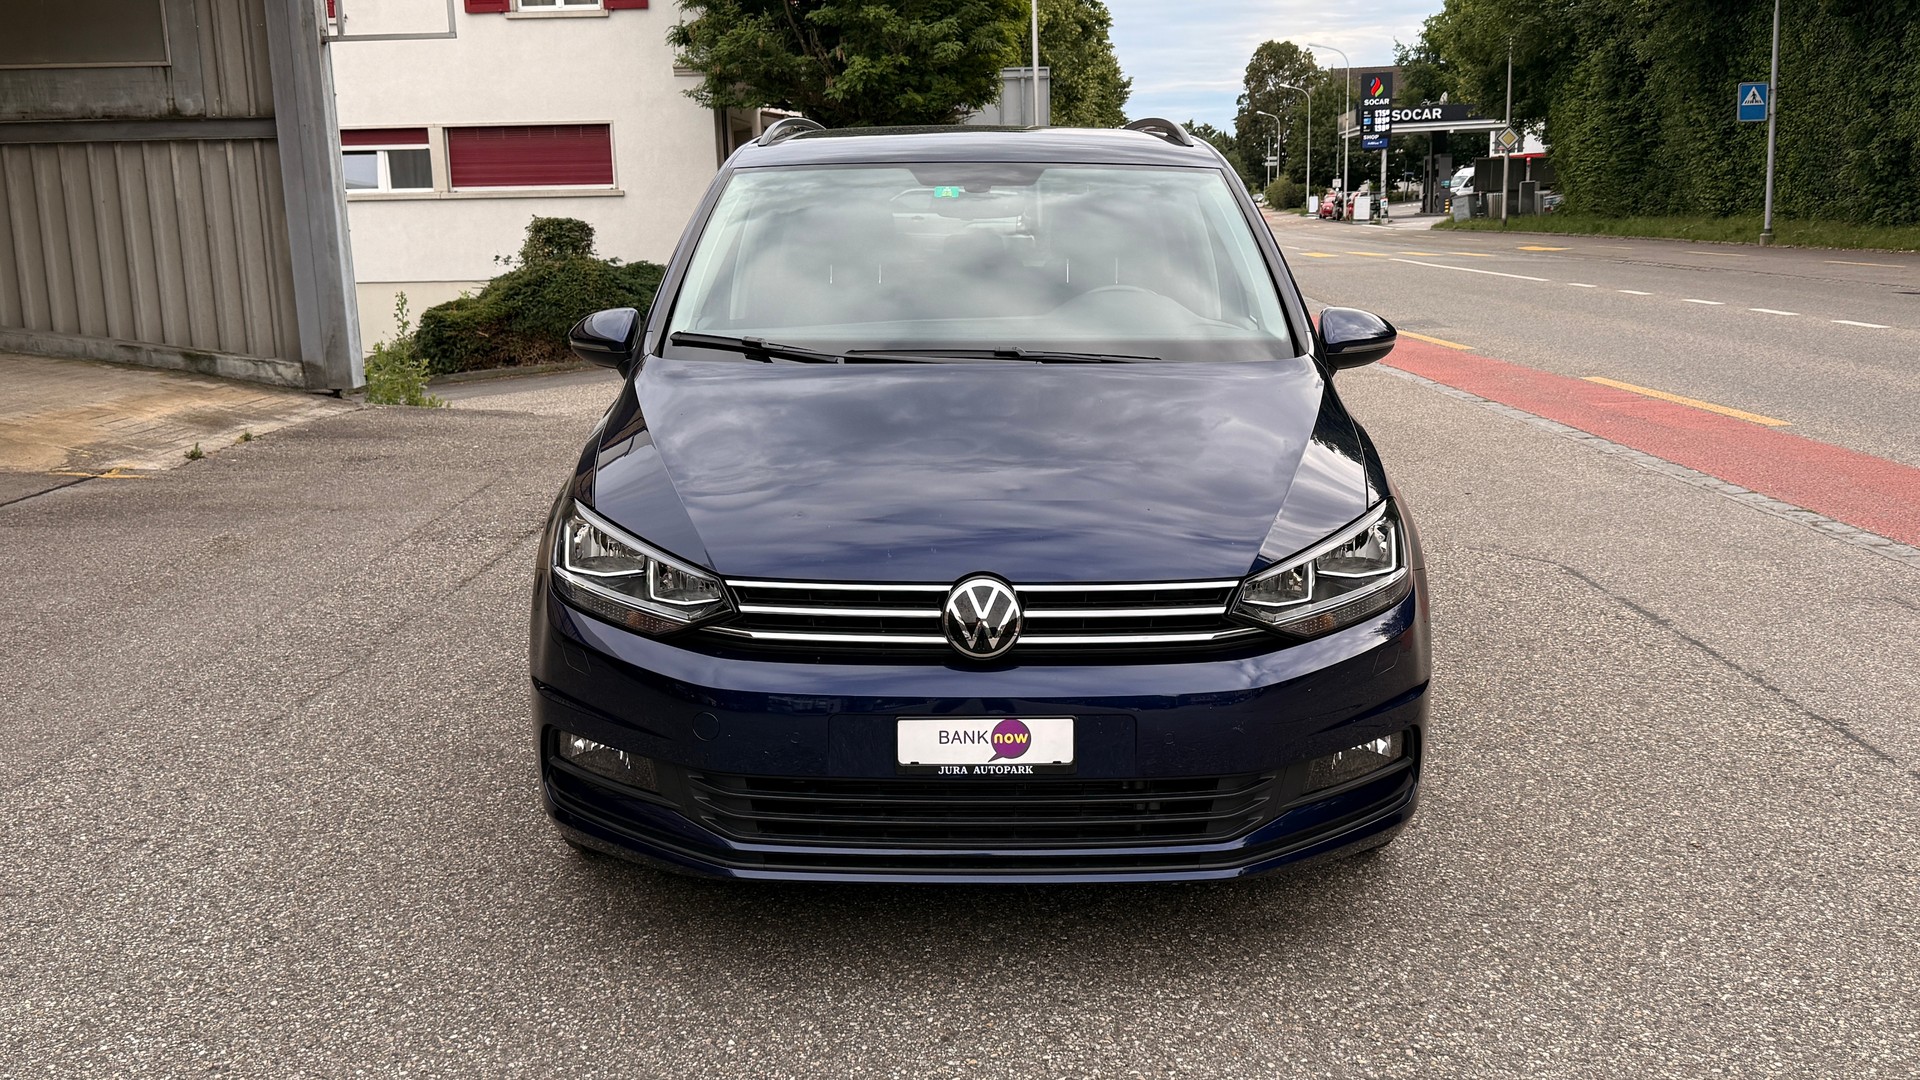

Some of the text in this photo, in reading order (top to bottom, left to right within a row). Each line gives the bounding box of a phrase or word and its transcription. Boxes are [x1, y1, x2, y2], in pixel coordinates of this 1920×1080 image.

[1364, 98, 1390, 106] SOCAR
[1391, 107, 1442, 121] SOCAR
[938, 730, 1029, 745] BANK now
[938, 765, 1034, 775] JURA AUTOPARK
